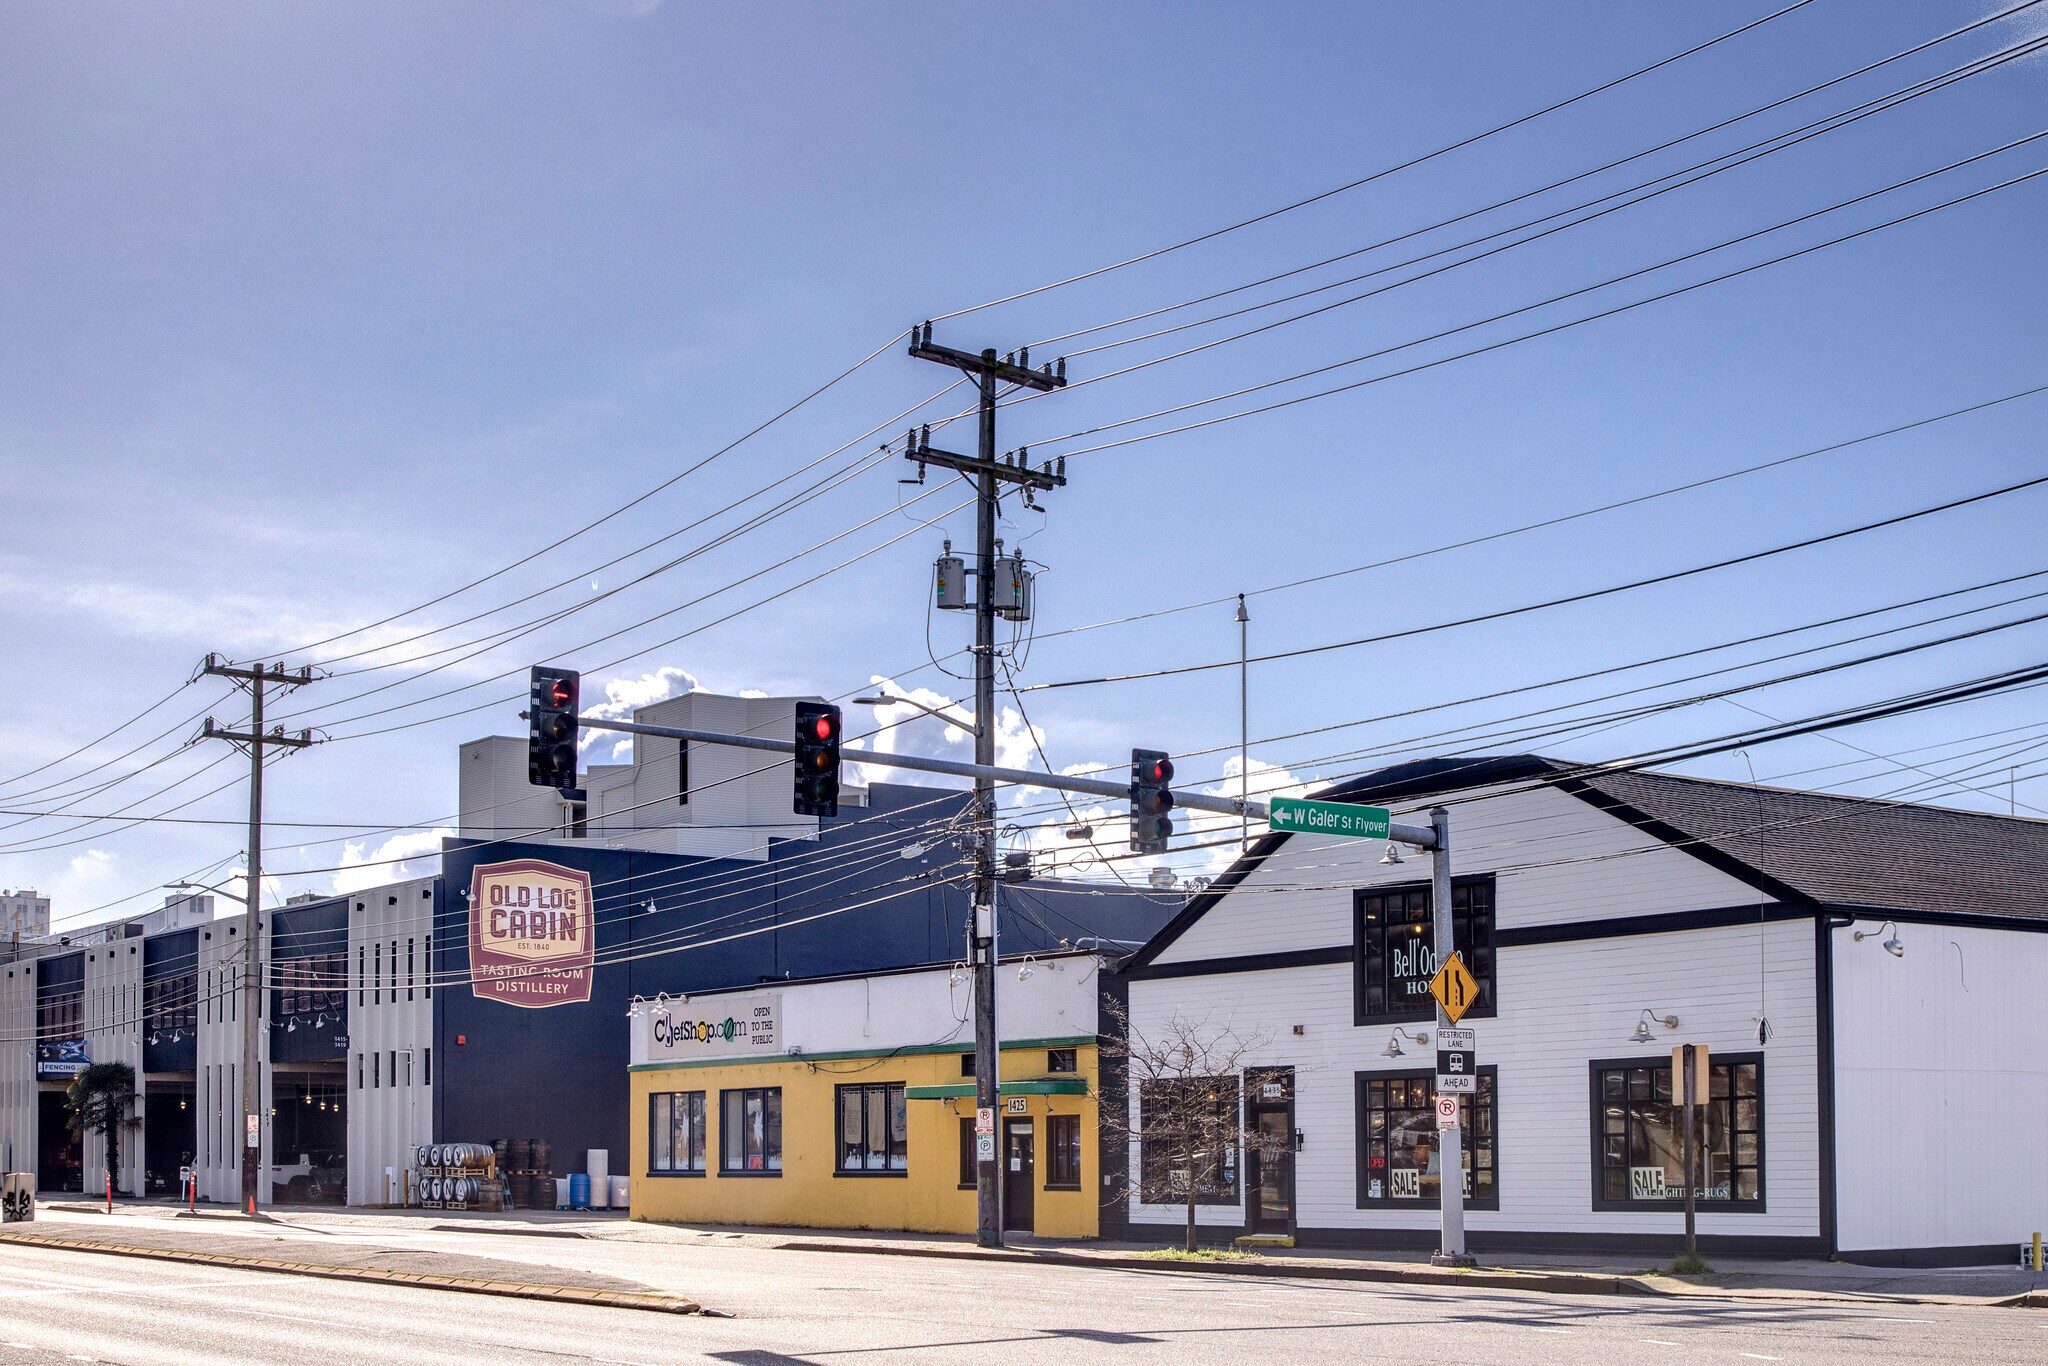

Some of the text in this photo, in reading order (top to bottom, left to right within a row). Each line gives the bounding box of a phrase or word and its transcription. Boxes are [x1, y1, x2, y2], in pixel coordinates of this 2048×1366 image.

[1294, 808, 1387, 833] W Galer St Flyover
[490, 884, 576, 910] OLD LOG
[490, 908, 577, 941] CABIN
[517, 942, 550, 951] EST. 1840
[481, 965, 583, 979] TASTING ROOM
[496, 981, 568, 994] DISTILLERY
[753, 1006, 771, 1018] OPEN
[654, 1013, 747, 1047] ChefShop.com
[751, 1020, 773, 1032] TO THE
[751, 1034, 773, 1045] PUBLIC
[1438, 1030, 1473, 1040] RESTRICTED
[1447, 1040, 1463, 1048] LANE
[1443, 1078, 1469, 1088] AHEAD
[1010, 1100, 1024, 1111] 1425
[1394, 1171, 1418, 1196] SALE
[1634, 1170, 1663, 1196] SALE
